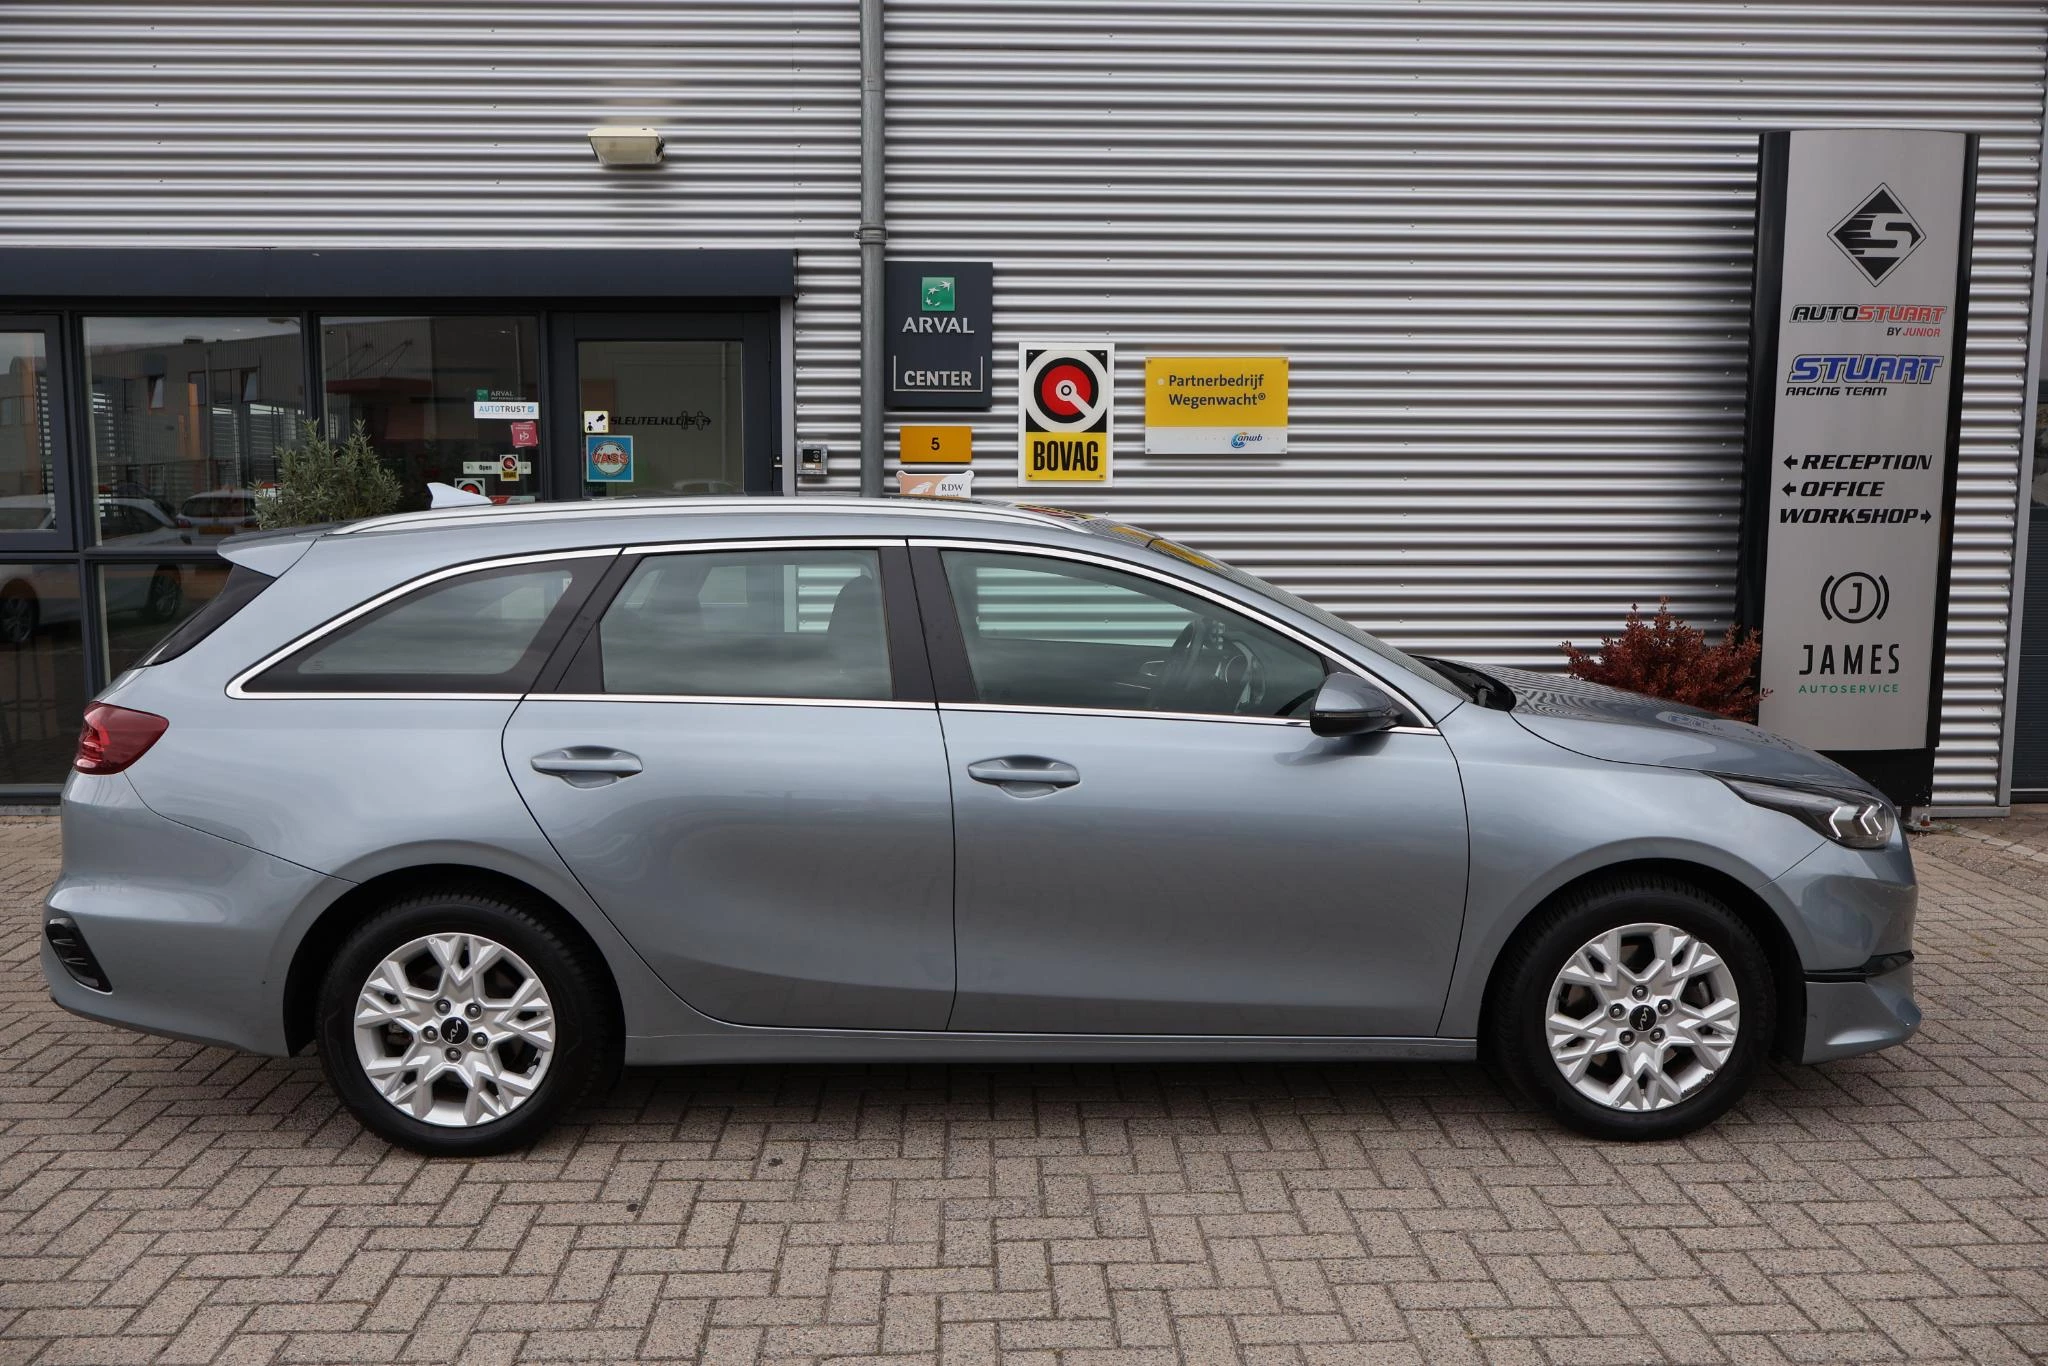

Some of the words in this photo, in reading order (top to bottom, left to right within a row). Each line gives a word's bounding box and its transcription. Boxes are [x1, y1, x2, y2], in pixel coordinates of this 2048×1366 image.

[1789, 304, 1947, 323] AUTOSTUART
[902, 317, 975, 334] ARVAL
[1886, 327, 1902, 336] BY
[1902, 327, 1941, 336] JUNIOR
[1787, 353, 1944, 385] STUART
[903, 370, 972, 386] CENTER
[1169, 374, 1265, 390] Partnerbedrijf
[1785, 387, 1840, 396] RACING
[1845, 387, 1888, 396] TEAM
[479, 405, 526, 413] AUTOTRUST
[930, 437, 940, 451] 5
[1237, 433, 1263, 442] anwb
[592, 452, 629, 465] VASS
[1033, 440, 1099, 472] BOVAG
[1801, 454, 1933, 470] RECEPTION
[478, 464, 492, 472] Open
[941, 484, 964, 492] RDW
[1800, 481, 1886, 497] OFFICE
[1779, 508, 1919, 524] WORKSHOP
[1799, 643, 1900, 676] JAMES
[1798, 683, 1899, 694] AUTOSERVICE
